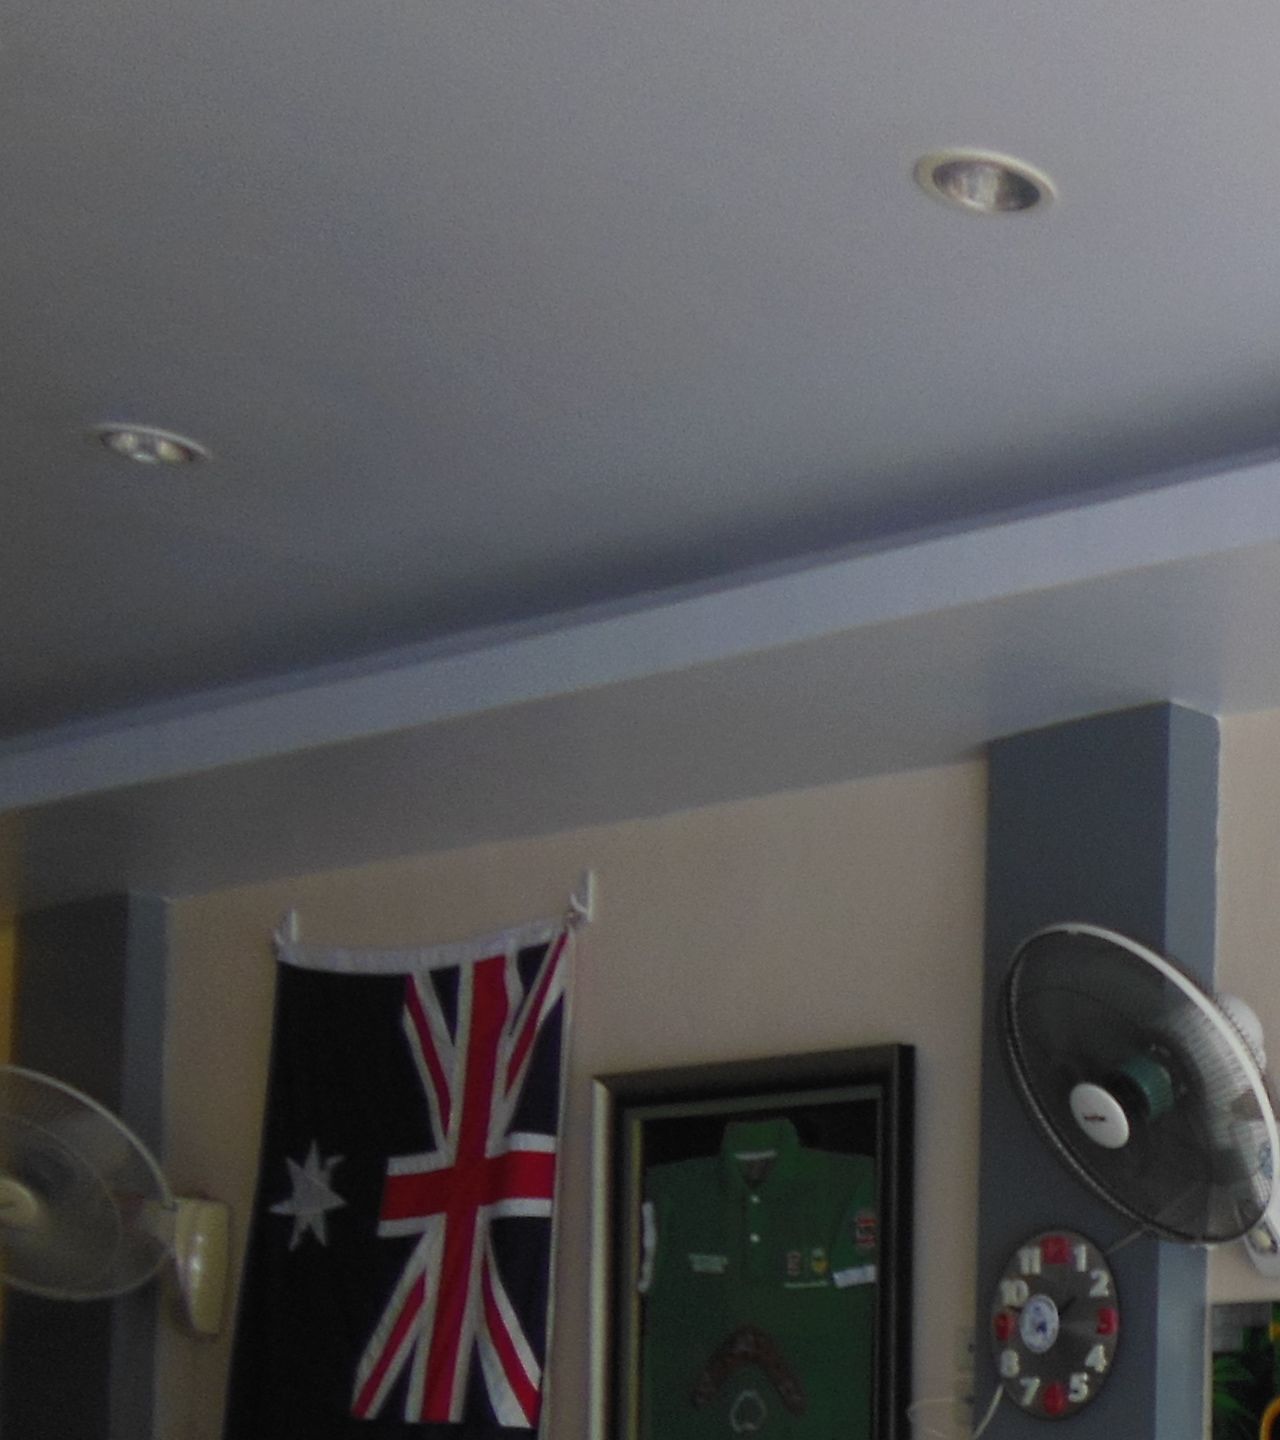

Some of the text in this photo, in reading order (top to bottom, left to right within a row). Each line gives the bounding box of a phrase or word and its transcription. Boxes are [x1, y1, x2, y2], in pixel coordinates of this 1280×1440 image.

[1000, 1278, 1029, 1307] 10
[1089, 1269, 1109, 1297] 2
[1084, 1343, 1107, 1372] 4
[1020, 1376, 1040, 1405] 7
[1067, 1371, 1088, 1401] 5
